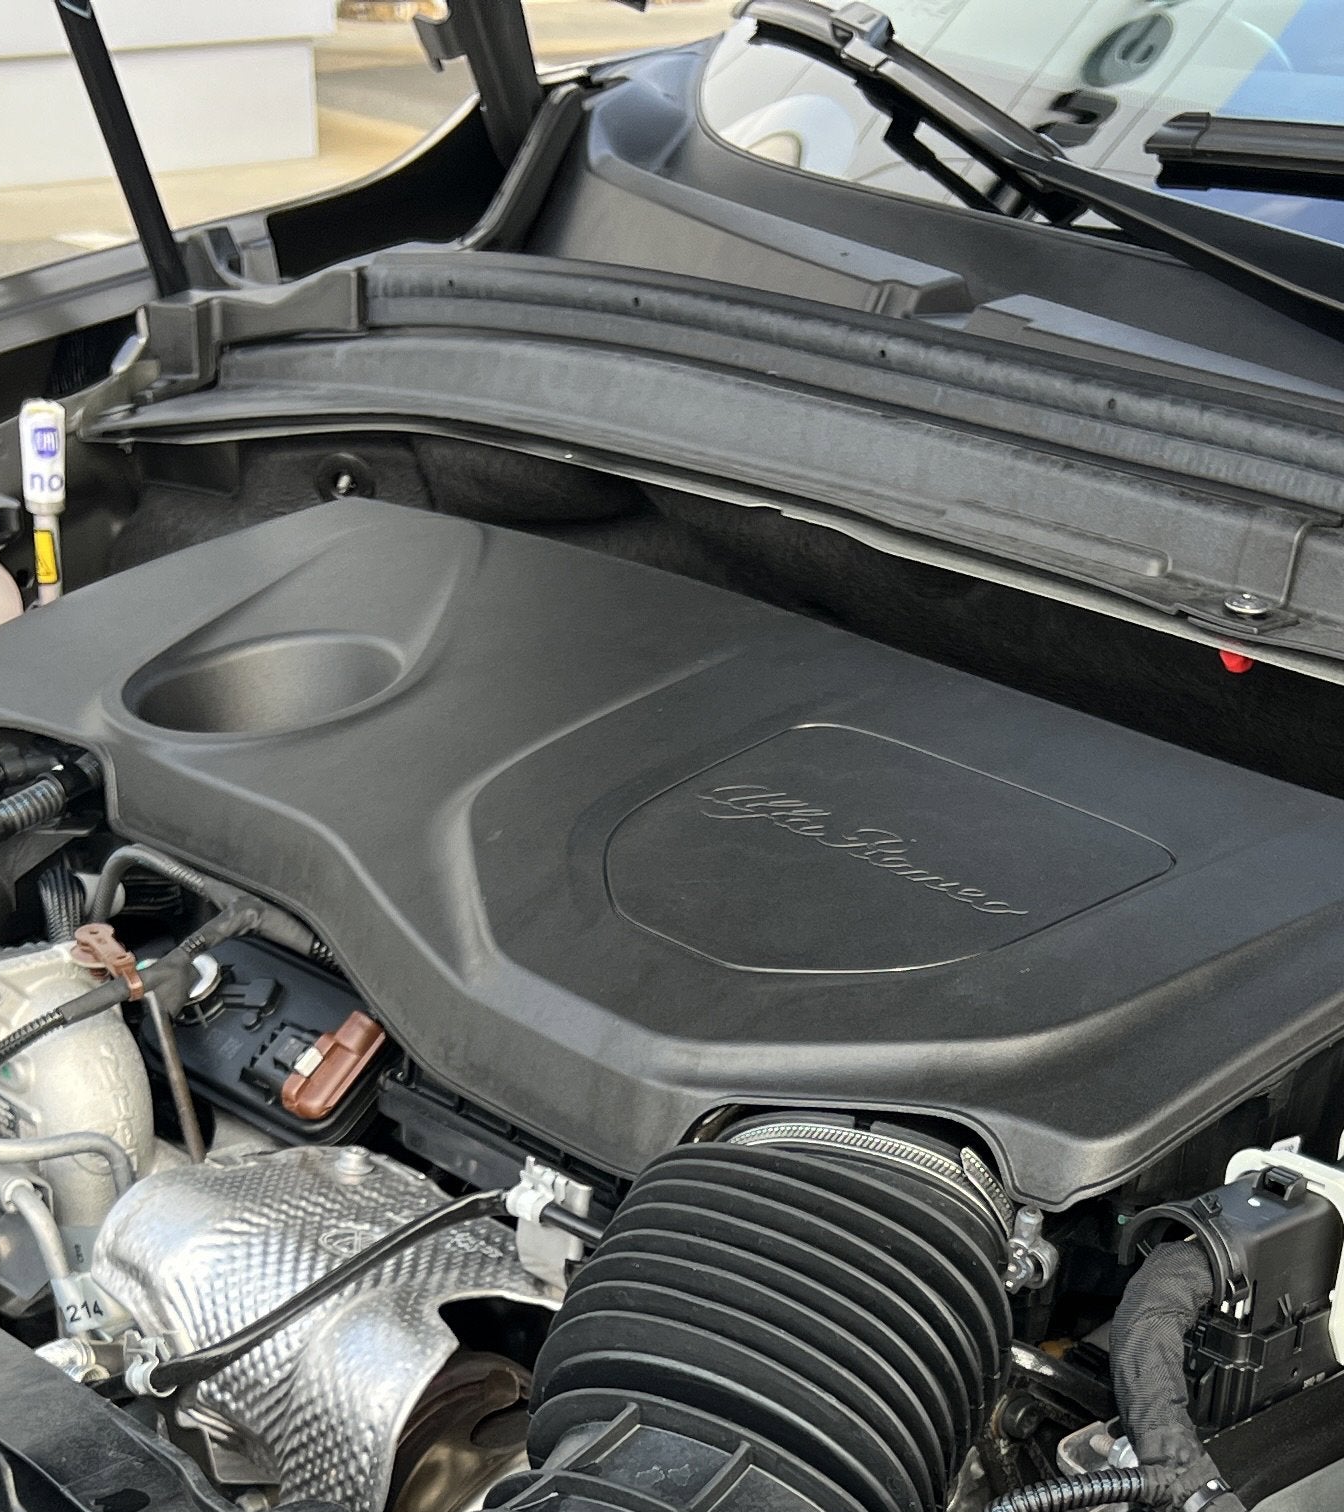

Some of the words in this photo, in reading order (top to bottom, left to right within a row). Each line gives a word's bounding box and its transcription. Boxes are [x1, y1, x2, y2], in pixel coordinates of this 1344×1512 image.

[696, 784, 832, 839] Alfa
[816, 827, 1029, 916] Romeo
[67, 1299, 104, 1322] 214
